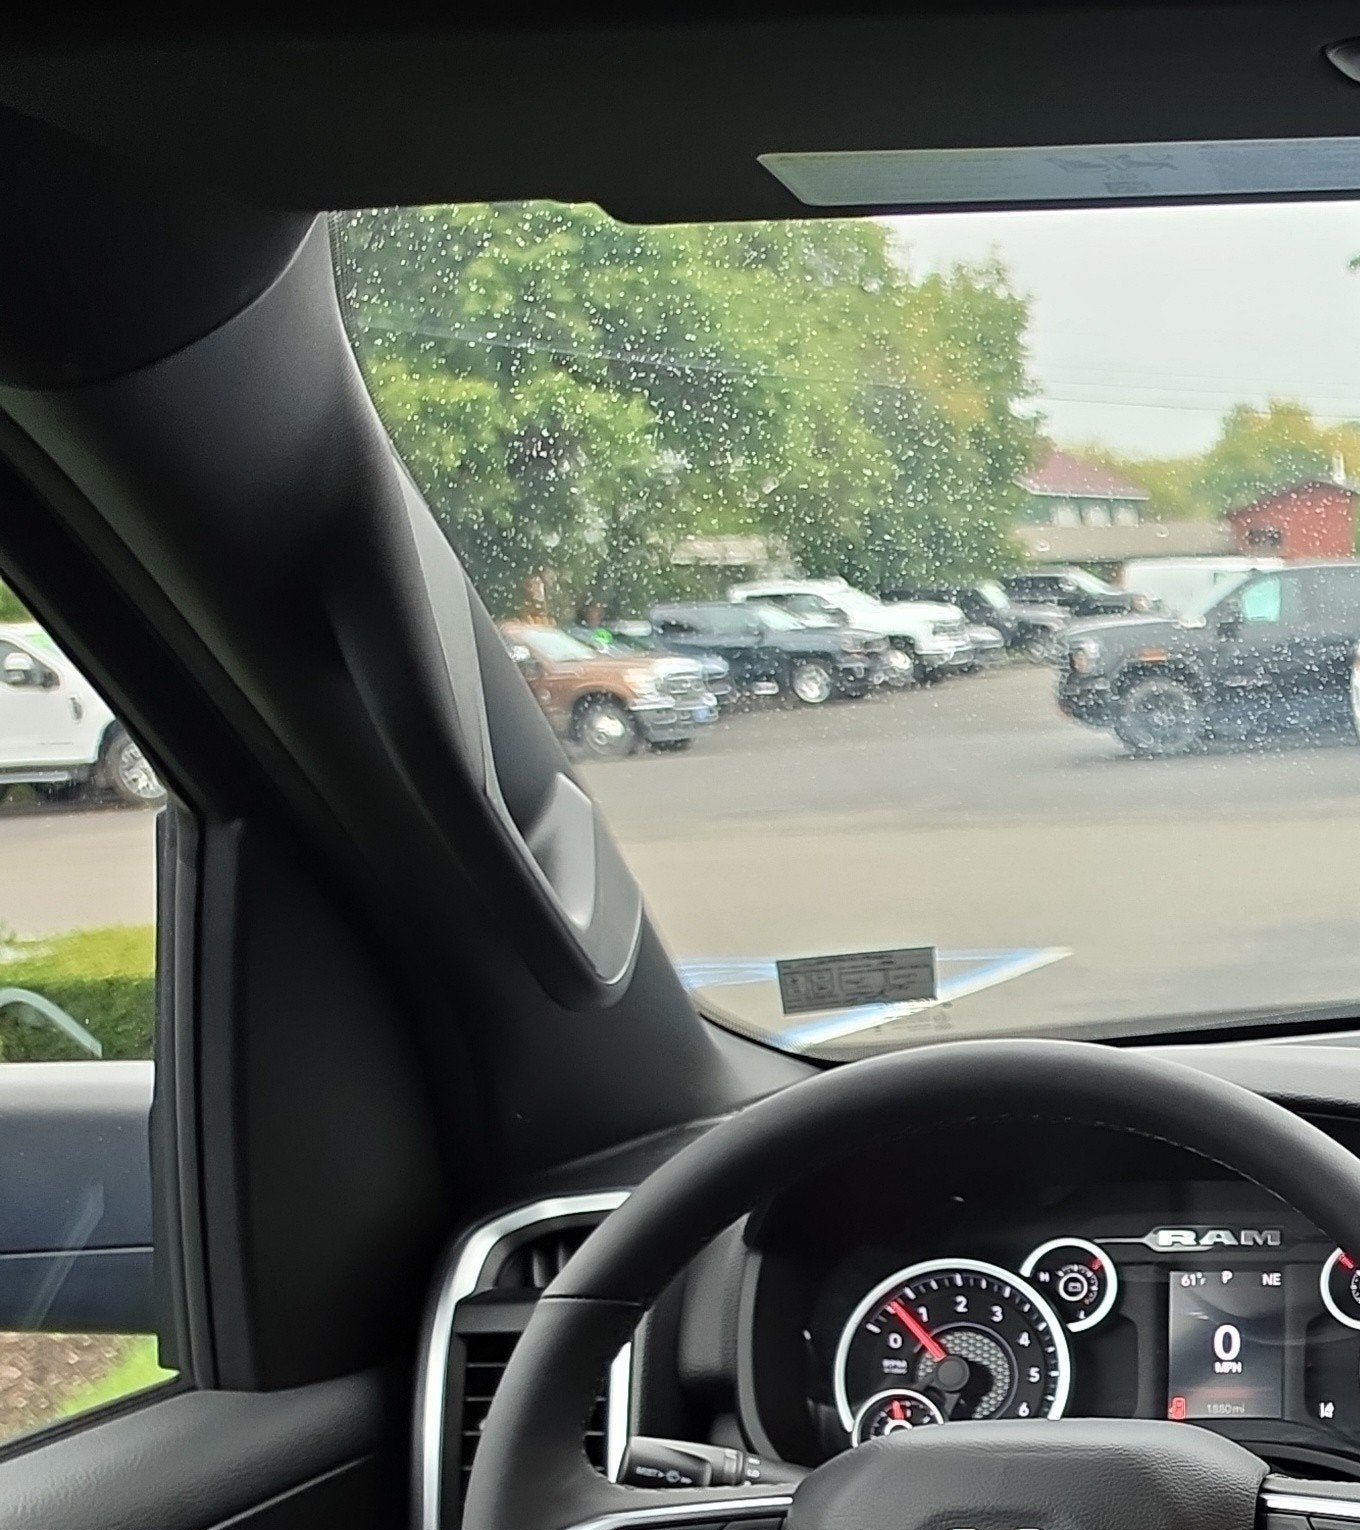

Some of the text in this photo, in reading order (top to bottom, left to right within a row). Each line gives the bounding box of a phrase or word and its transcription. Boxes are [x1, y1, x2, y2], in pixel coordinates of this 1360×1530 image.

[1158, 1230, 1281, 1247] RAM
[1221, 1271, 1233, 1284] P
[1262, 1273, 1282, 1286] NE
[954, 1295, 969, 1313] 2
[917, 1306, 929, 1323] 1
[991, 1305, 1004, 1323] 3
[887, 1332, 903, 1349] 0
[1017, 1331, 1031, 1347] 4
[1213, 1324, 1241, 1361] 0
[1028, 1366, 1041, 1383] 5
[1214, 1362, 1242, 1374] MPH
[1017, 1401, 1031, 1418] 6
